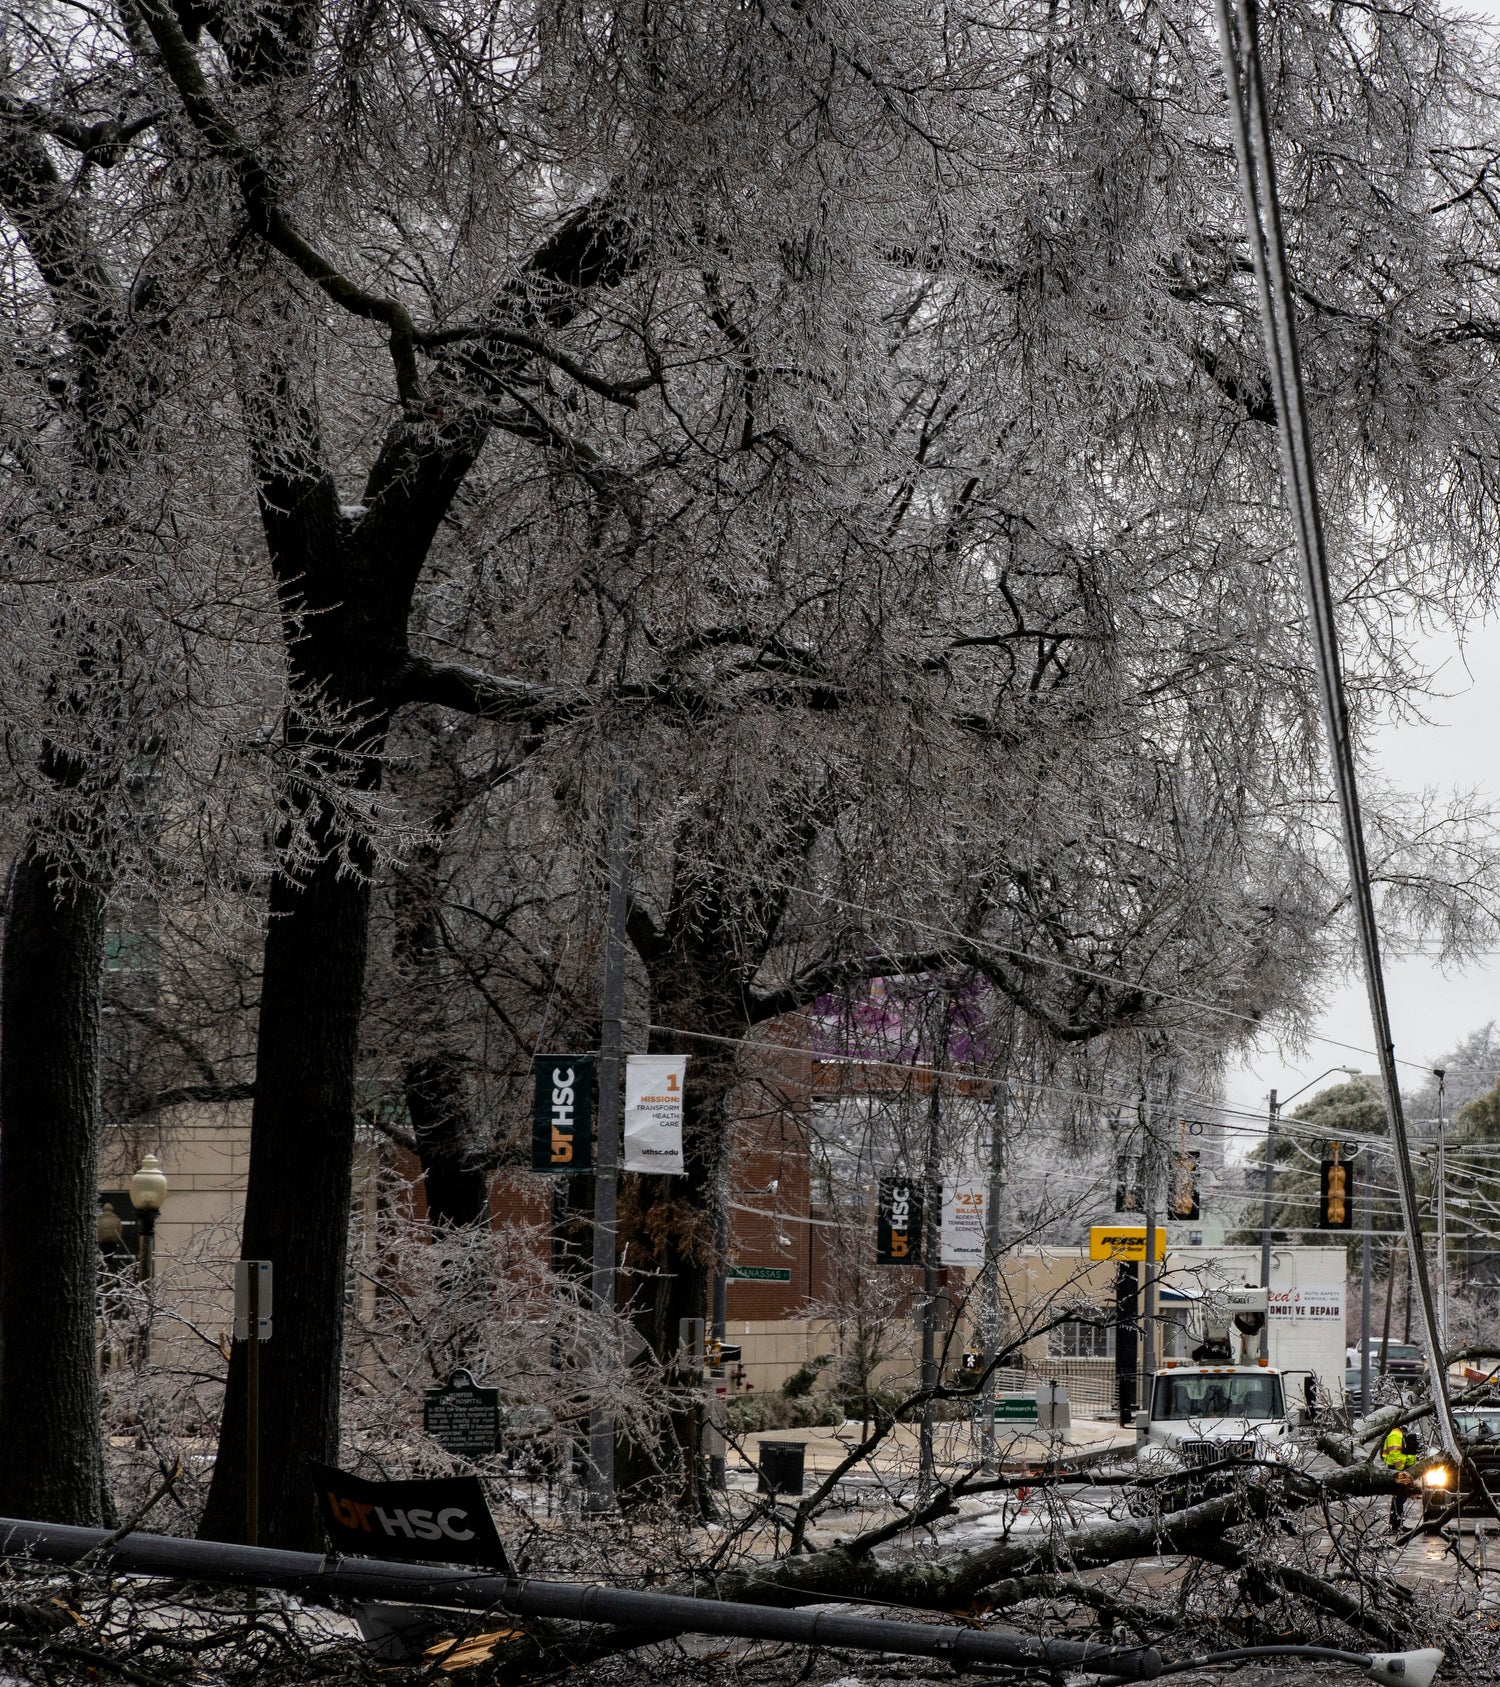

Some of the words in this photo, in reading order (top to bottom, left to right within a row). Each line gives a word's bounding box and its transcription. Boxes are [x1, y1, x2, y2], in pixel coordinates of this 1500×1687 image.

[666, 1073, 680, 1092] 1
[1101, 1237, 1147, 1245] PENSK
[736, 1269, 782, 1279] MANASSAS
[1267, 1286, 1301, 1302] eed's
[1310, 1306, 1340, 1316] REPAIR
